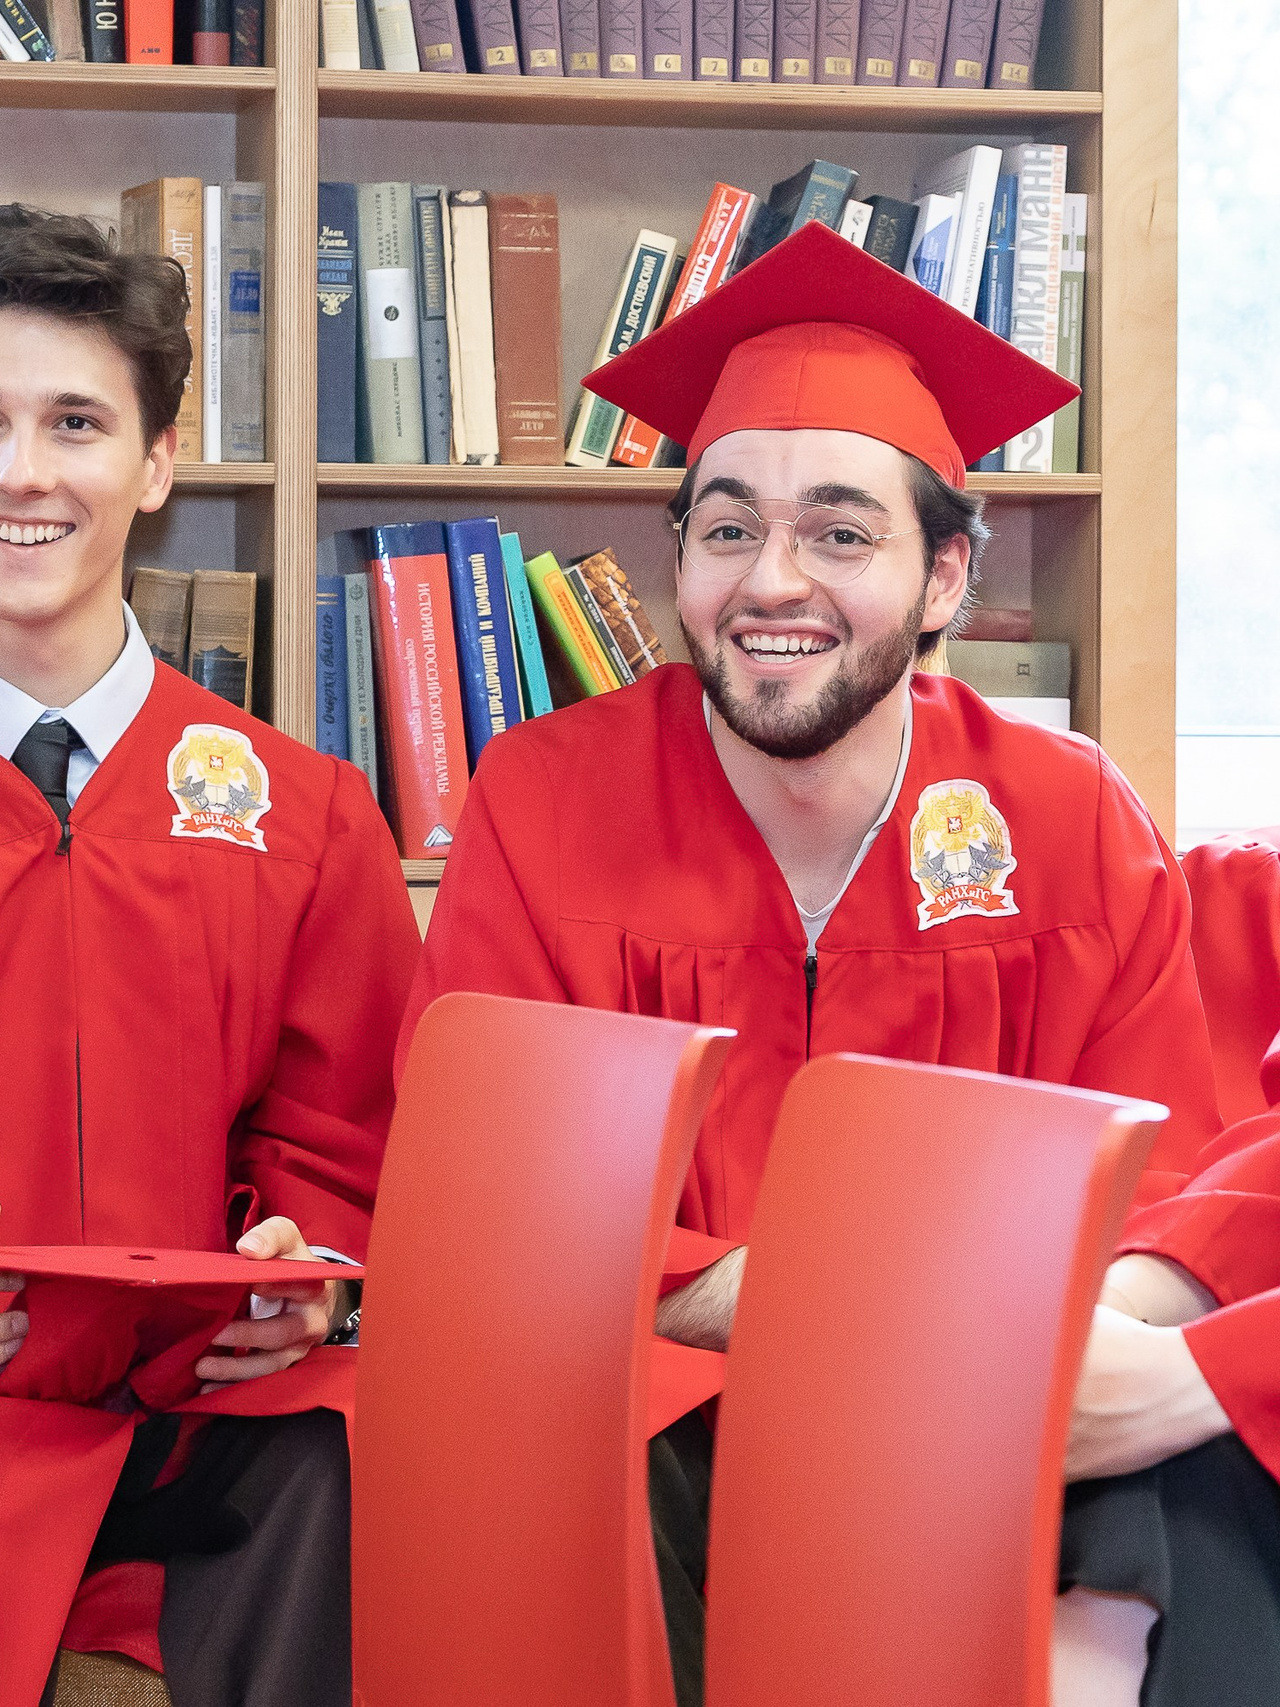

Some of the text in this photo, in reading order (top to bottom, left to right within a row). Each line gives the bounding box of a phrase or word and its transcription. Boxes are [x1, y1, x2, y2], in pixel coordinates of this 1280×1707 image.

[1052, 145, 1064, 203] власти
[962, 201, 985, 308] РЕЗУЛЬТАТИВНОСТЬЮ
[1046, 211, 1062, 314] социальной
[625, 255, 657, 330] ДОСТОЕВСКИЙ
[1014, 263, 1047, 360] айкл
[210, 342, 218, 405] БИБЛИОТЕЧКА
[1020, 426, 1044, 471] 2
[467, 552, 492, 616] КОМПАНИЙ
[354, 614, 362, 635] ДНИ
[479, 619, 493, 630] И
[320, 611, 336, 725] Очерки былого
[355, 637, 366, 690] ХОЛОДНЫЕ
[402, 638, 424, 746] современный период
[416, 582, 450, 796] ИСТОРИЯ РОССИЙСКОЙ РЕКЛАМЫ:
[477, 634, 505, 715] ПРЕДПРИЯТИЙ
[192, 813, 244, 833] РАНХиГС
[936, 885, 992, 908] РАНХиГС
